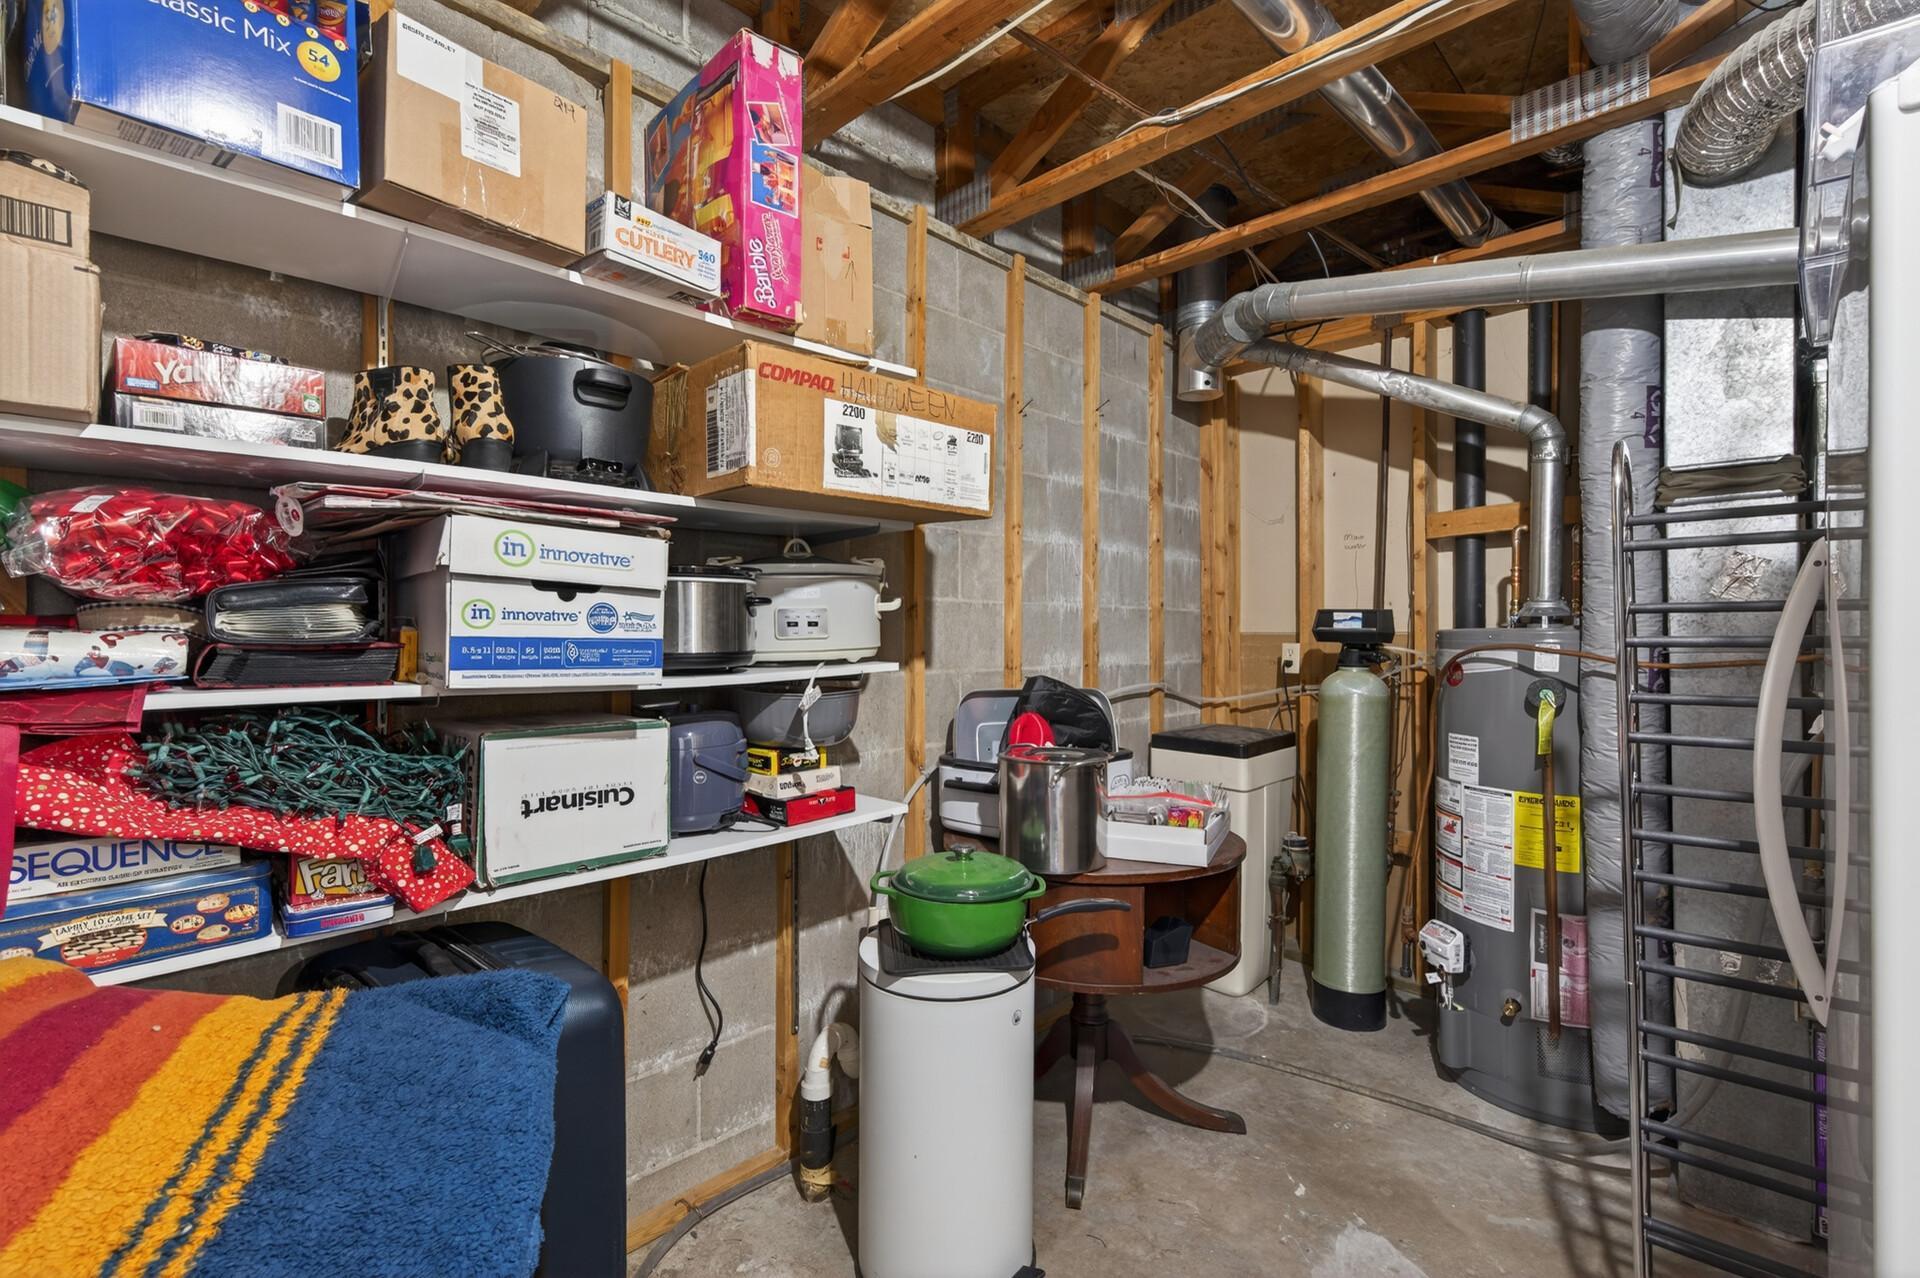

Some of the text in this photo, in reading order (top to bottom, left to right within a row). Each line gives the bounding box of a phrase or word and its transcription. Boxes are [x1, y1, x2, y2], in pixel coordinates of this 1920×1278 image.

[149, 0, 292, 57] assic Mix
[308, 48, 330, 68] 54
[615, 227, 696, 269] CUTLERY
[748, 238, 777, 309] Barbie
[758, 362, 836, 393] COMPAQ
[840, 371, 957, 420] HALLOWEEN
[842, 404, 866, 420] 2200
[502, 536, 632, 569] in innovative
[470, 603, 492, 620] in
[501, 607, 579, 622] innovative
[521, 786, 635, 819] Cuisinart
[55, 921, 90, 936] FAMILY
